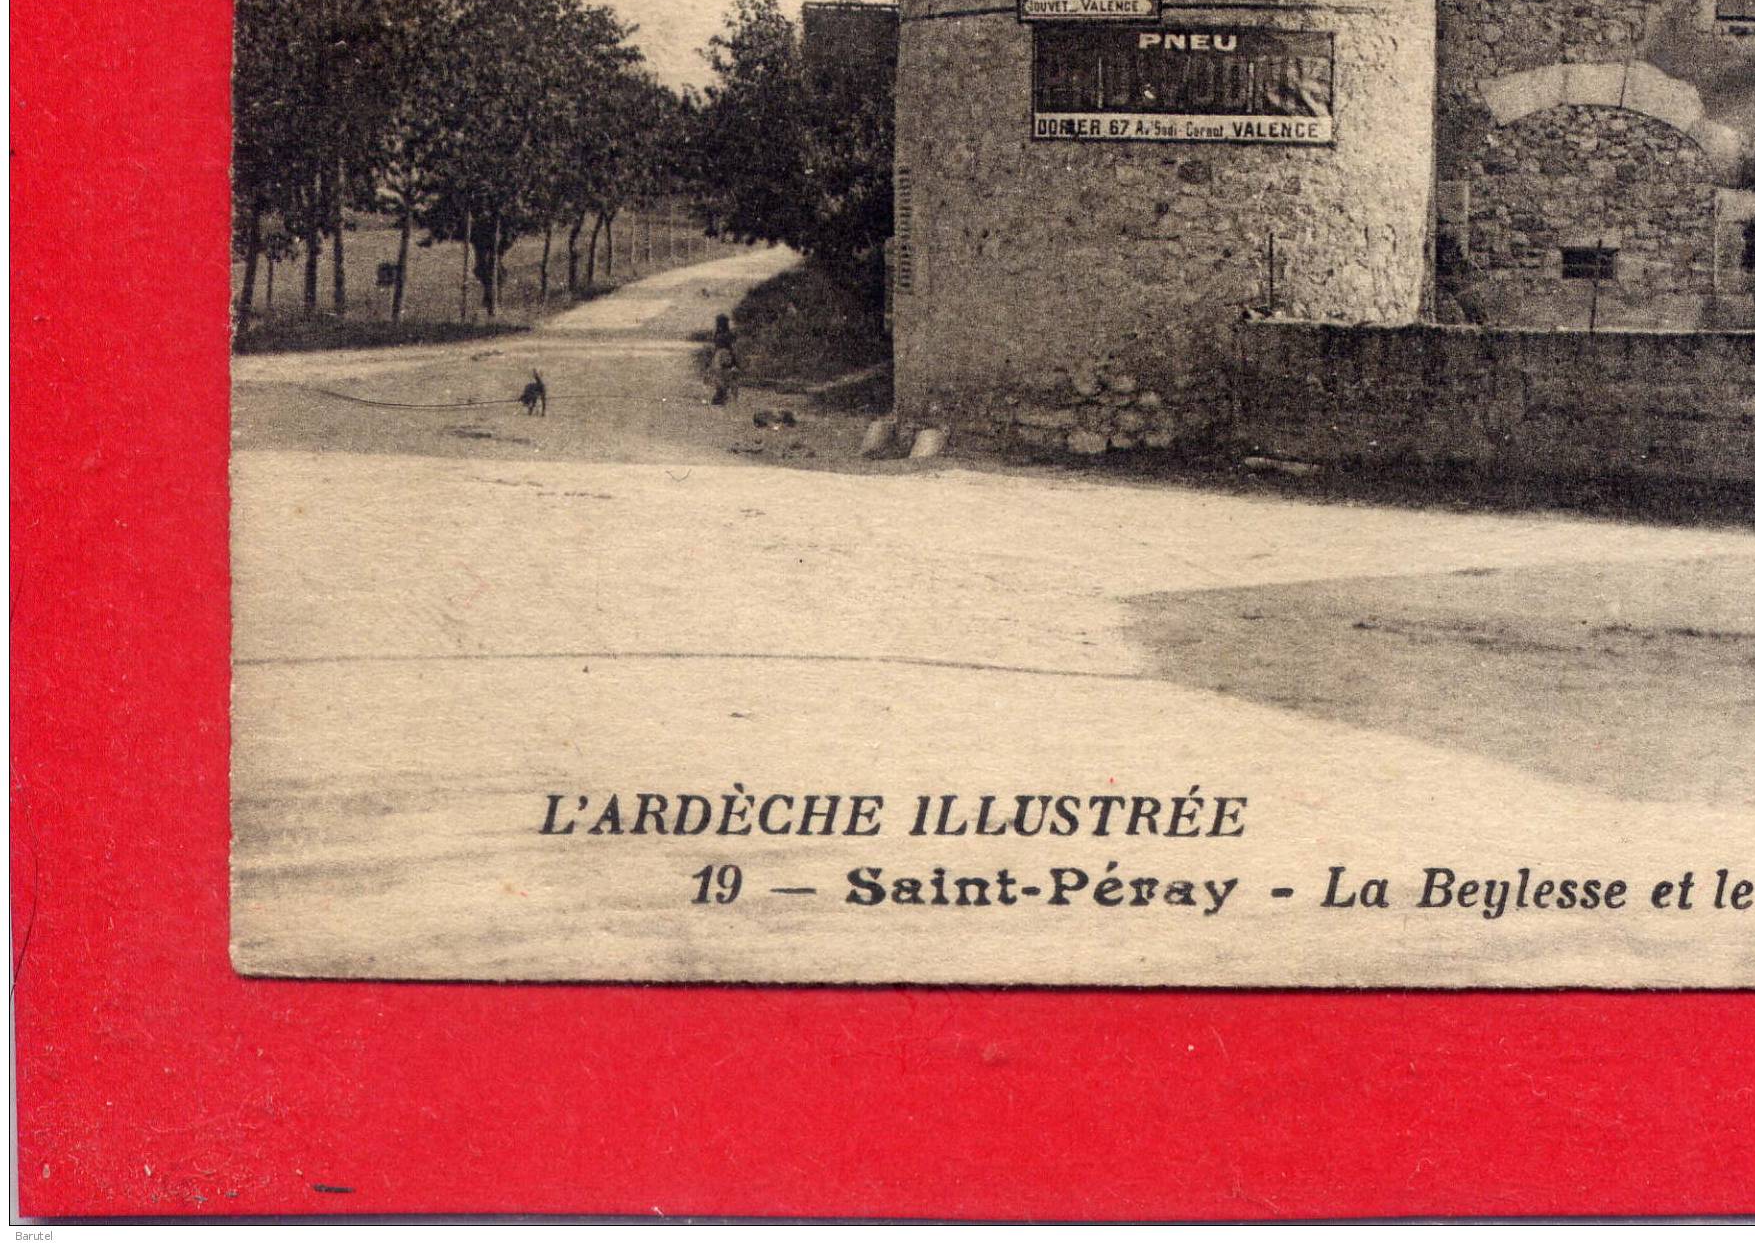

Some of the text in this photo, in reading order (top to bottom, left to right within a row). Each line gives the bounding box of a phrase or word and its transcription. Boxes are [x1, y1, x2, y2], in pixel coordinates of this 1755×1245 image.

[1138, 32, 1238, 52] PNEU
[1037, 119, 1101, 136] DORER
[1109, 119, 1129, 136] 67
[1232, 121, 1319, 138] VALENCE
